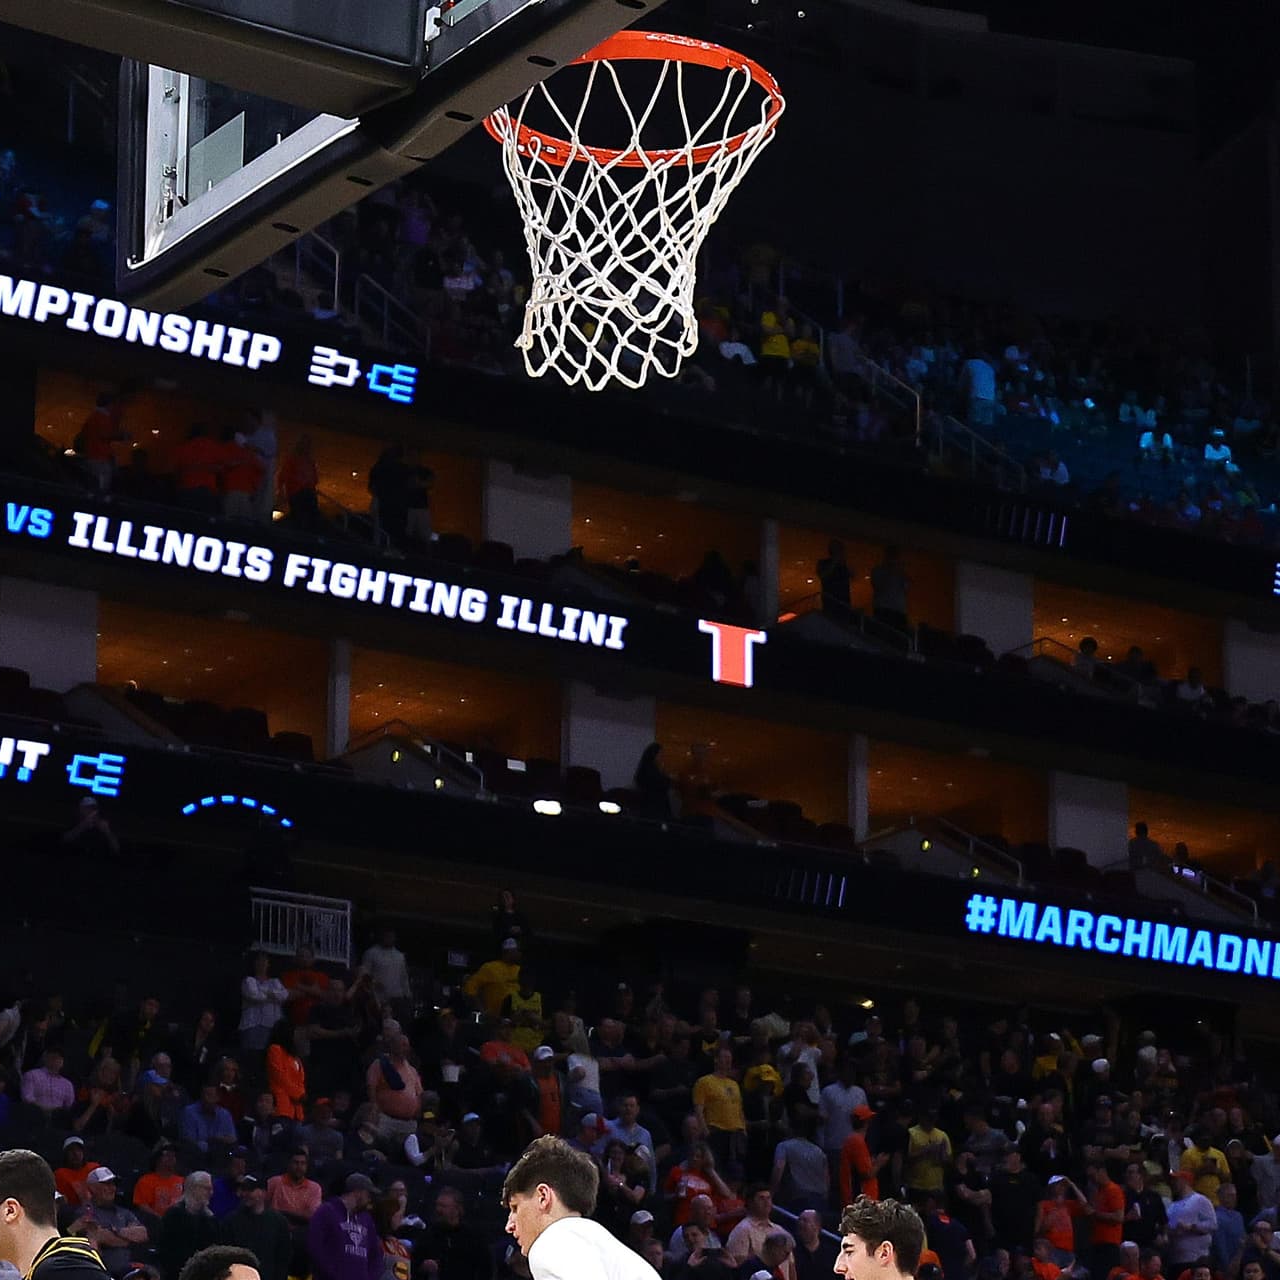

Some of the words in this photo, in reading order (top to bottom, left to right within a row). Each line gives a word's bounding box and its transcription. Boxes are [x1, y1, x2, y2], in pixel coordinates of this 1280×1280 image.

[68, 512, 274, 581] ILLINOIS
[284, 554, 488, 622] FIGHTING
[497, 595, 628, 649] ILLINI
